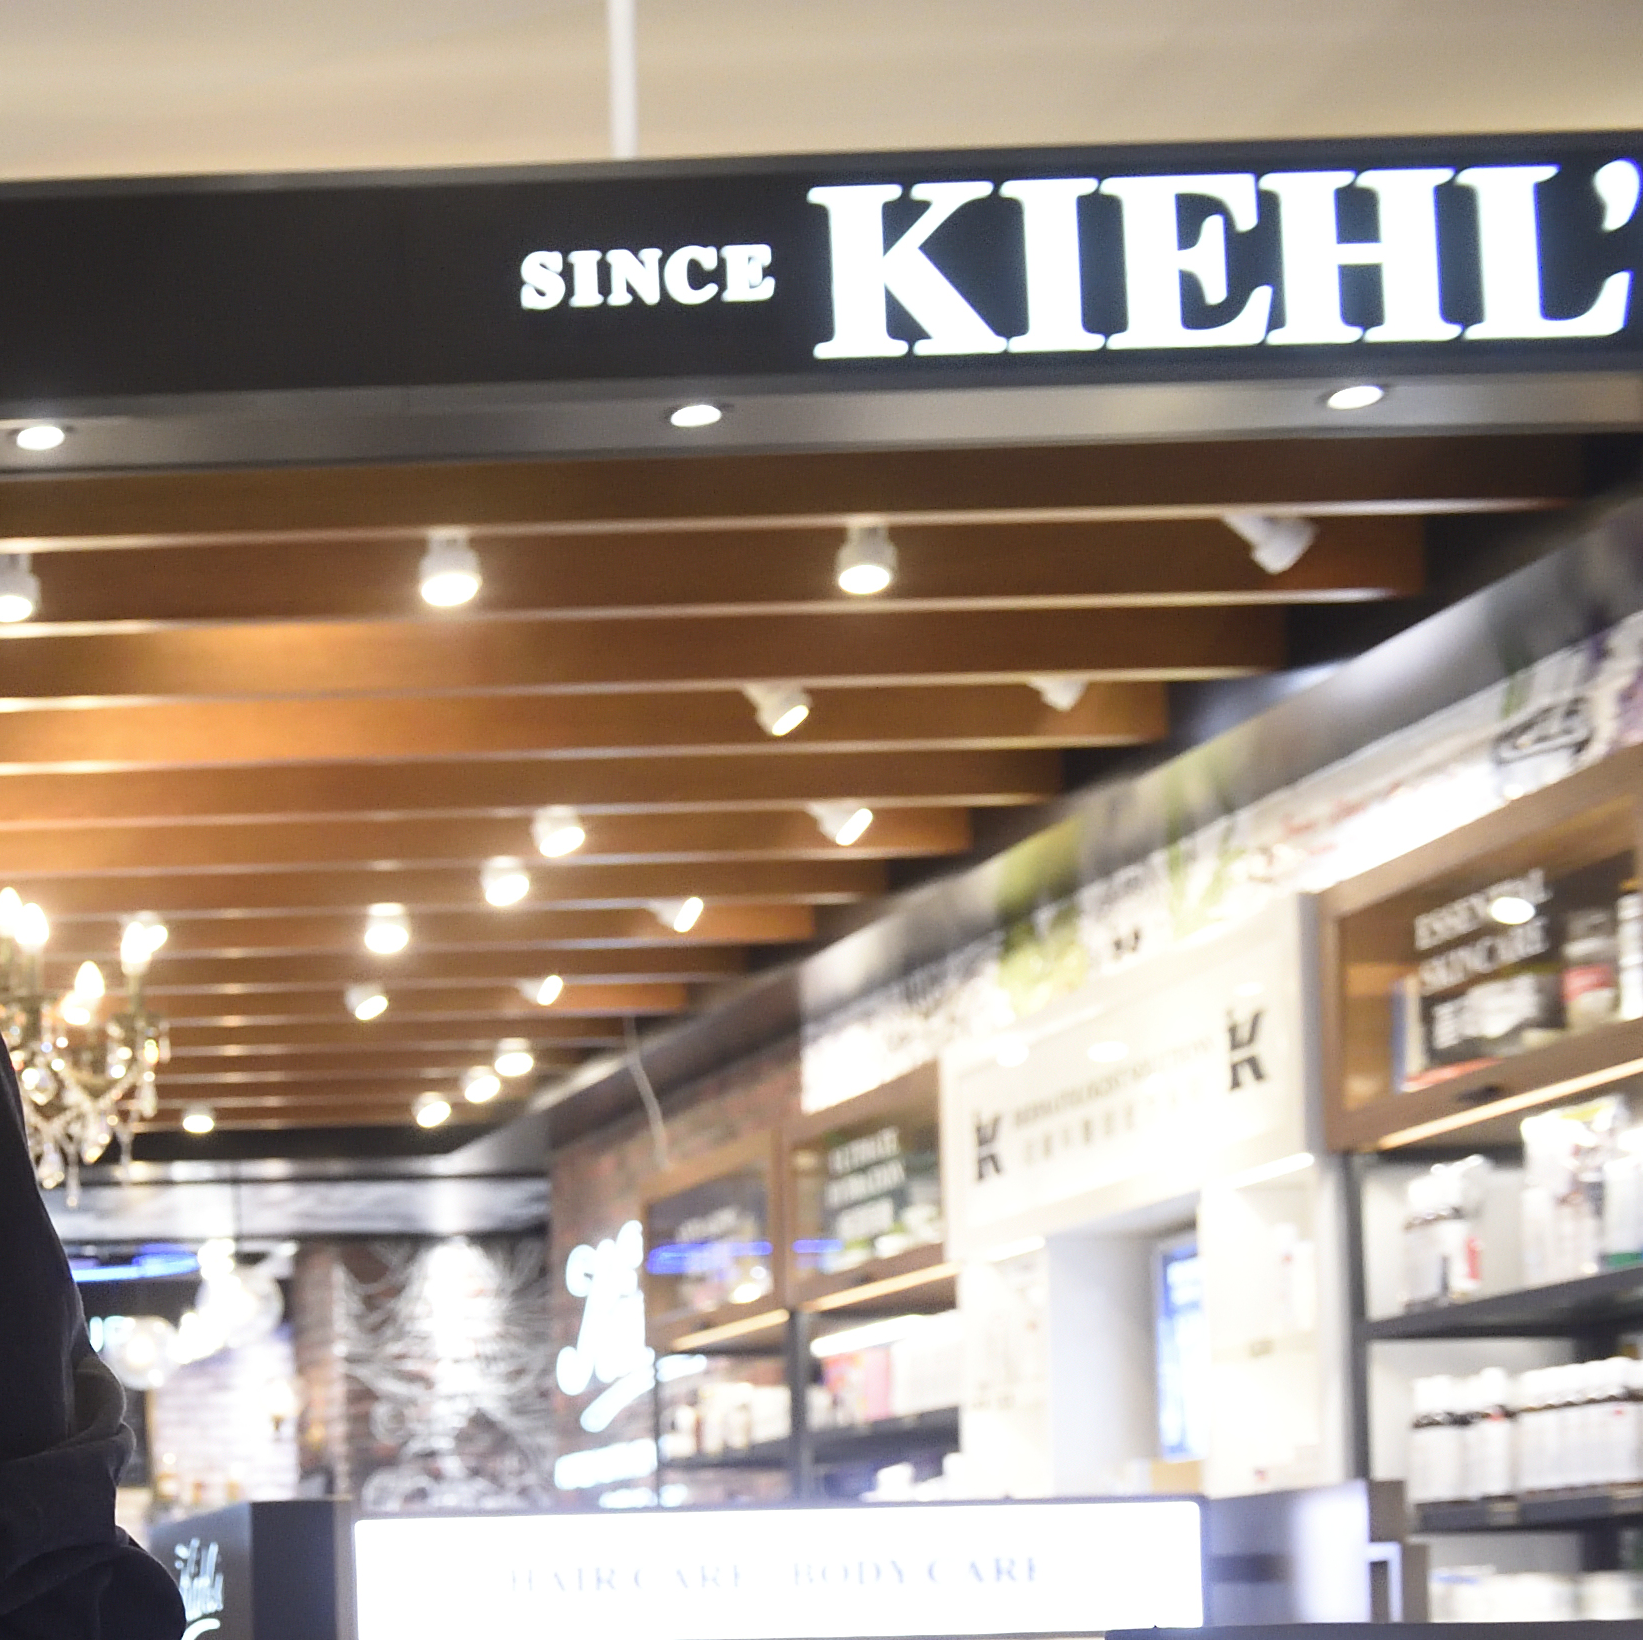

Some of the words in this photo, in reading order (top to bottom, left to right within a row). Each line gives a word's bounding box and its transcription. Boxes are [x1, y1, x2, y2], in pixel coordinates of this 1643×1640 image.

[519, 244, 775, 310] SINCE
[806, 158, 1641, 361] KIEHL'
[792, 1559, 905, 1588] BODY
